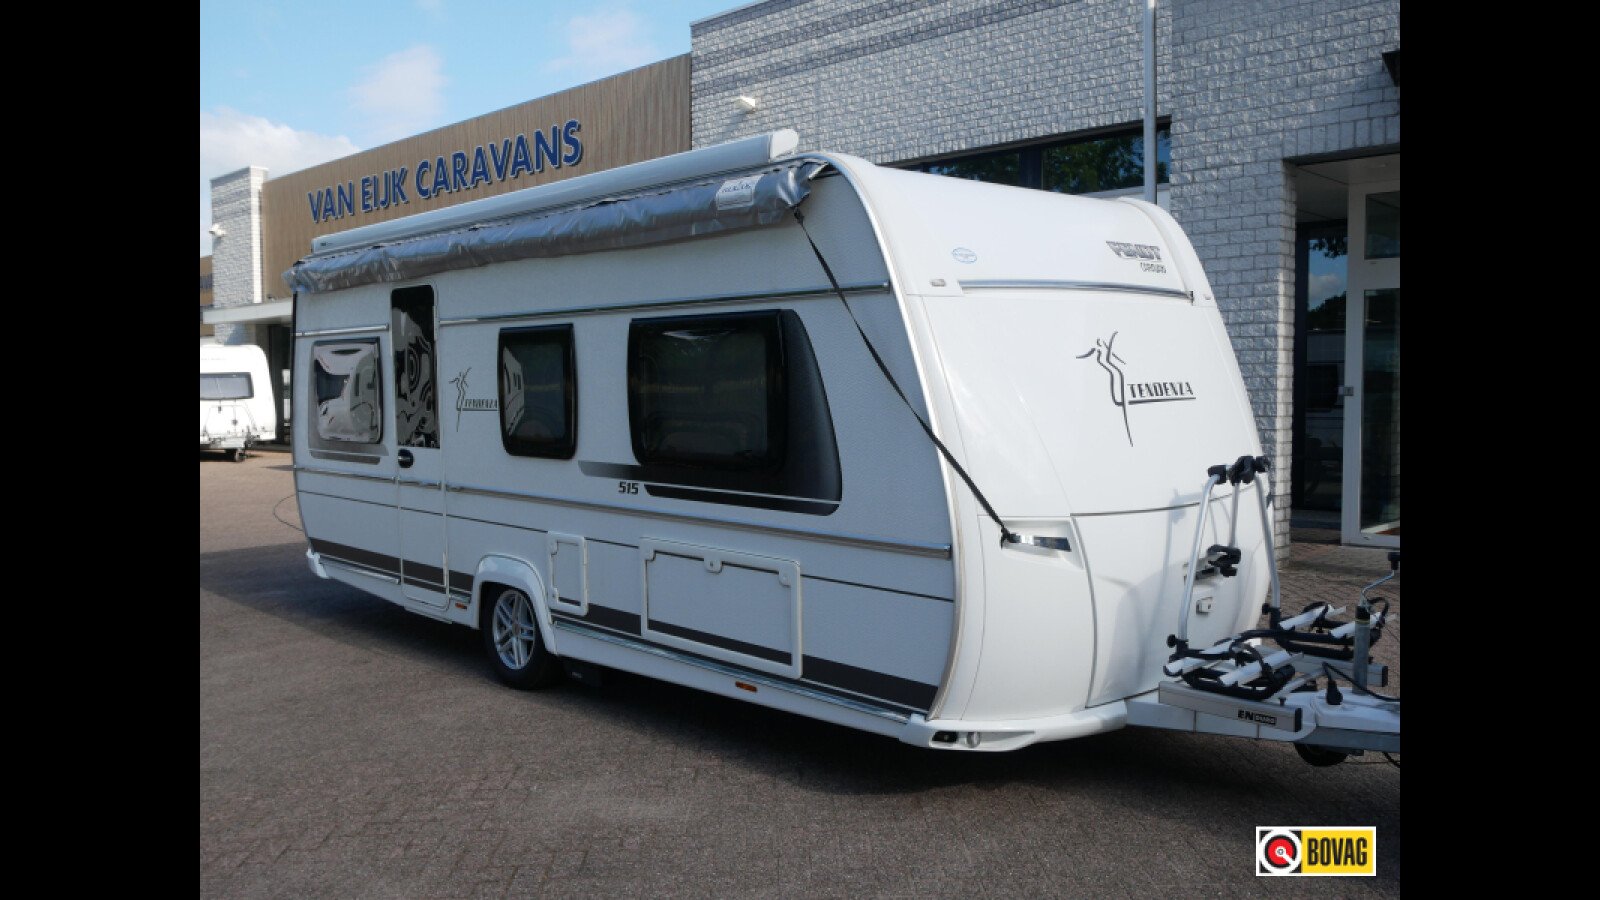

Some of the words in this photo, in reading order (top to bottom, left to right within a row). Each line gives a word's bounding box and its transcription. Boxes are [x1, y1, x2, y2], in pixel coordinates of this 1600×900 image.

[308, 180, 355, 223] VAN
[361, 167, 409, 213] EIJK
[415, 119, 583, 199] CARAVANS
[1127, 381, 1194, 398] TENDENZA
[618, 481, 639, 496] 515
